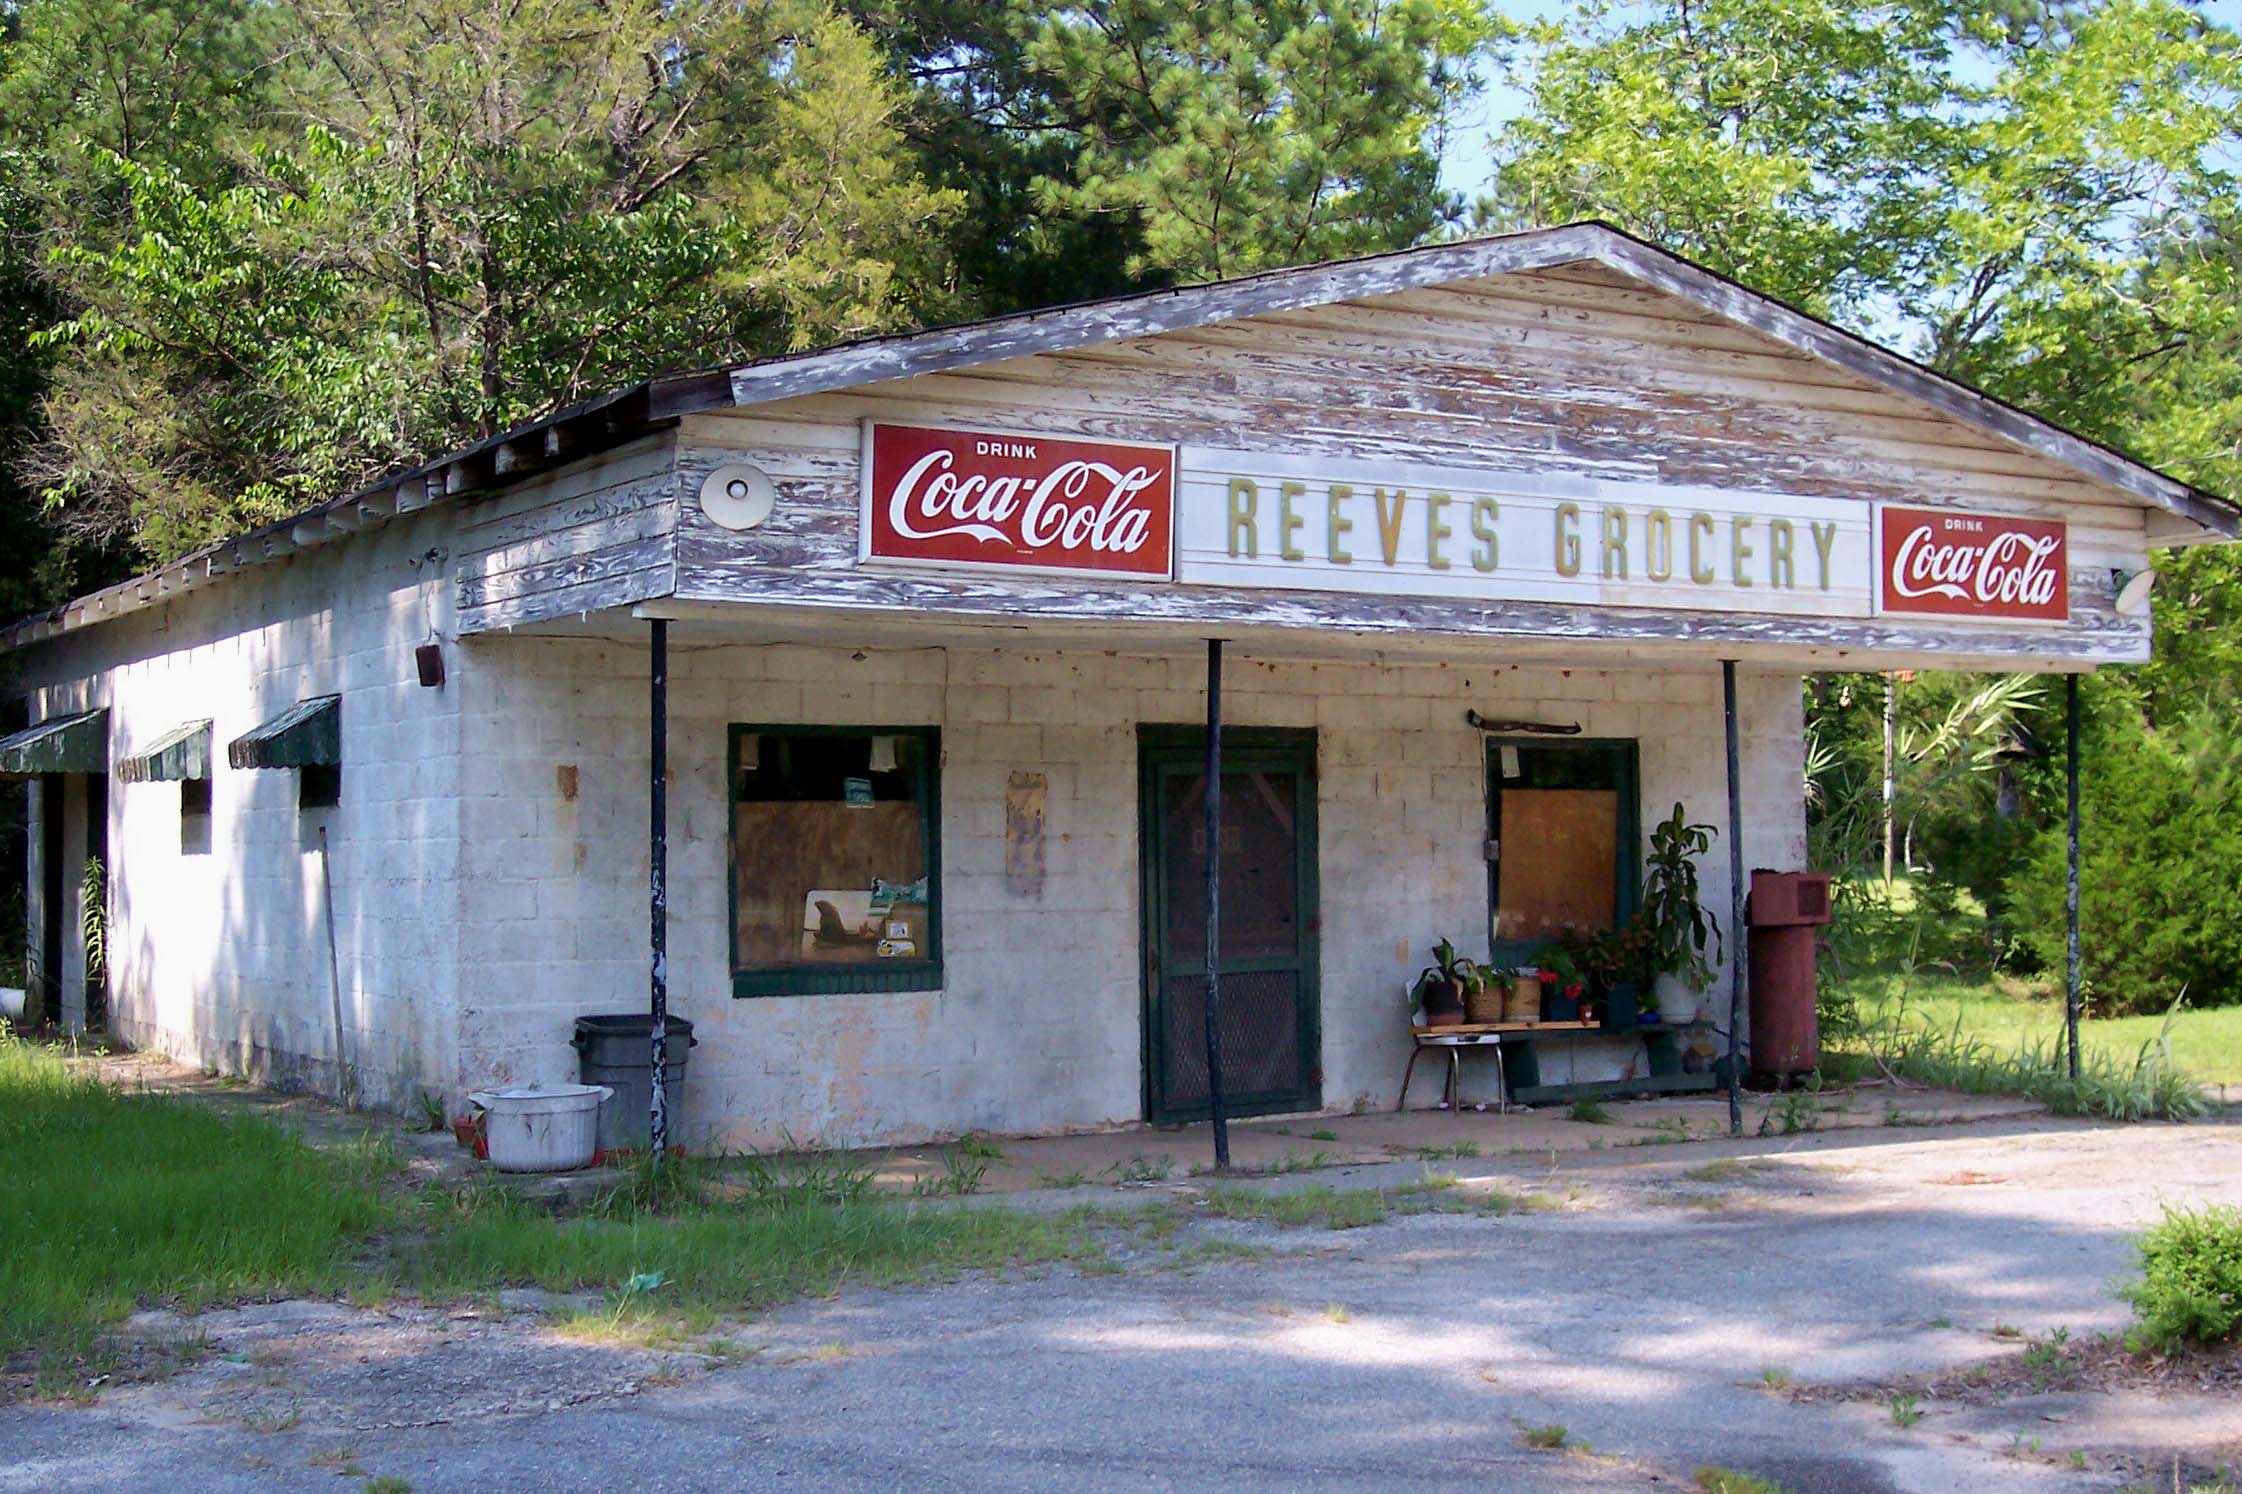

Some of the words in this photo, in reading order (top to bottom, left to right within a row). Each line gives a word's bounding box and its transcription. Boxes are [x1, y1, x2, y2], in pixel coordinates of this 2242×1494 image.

[976, 441, 1037, 460] DRINK
[889, 450, 1163, 553] Coca-Cola
[1228, 478, 1499, 573] REEVES
[1556, 502, 1836, 591] GROCERY
[1945, 518, 1983, 533] DRINK
[1892, 526, 2061, 605] Coca-Cola
